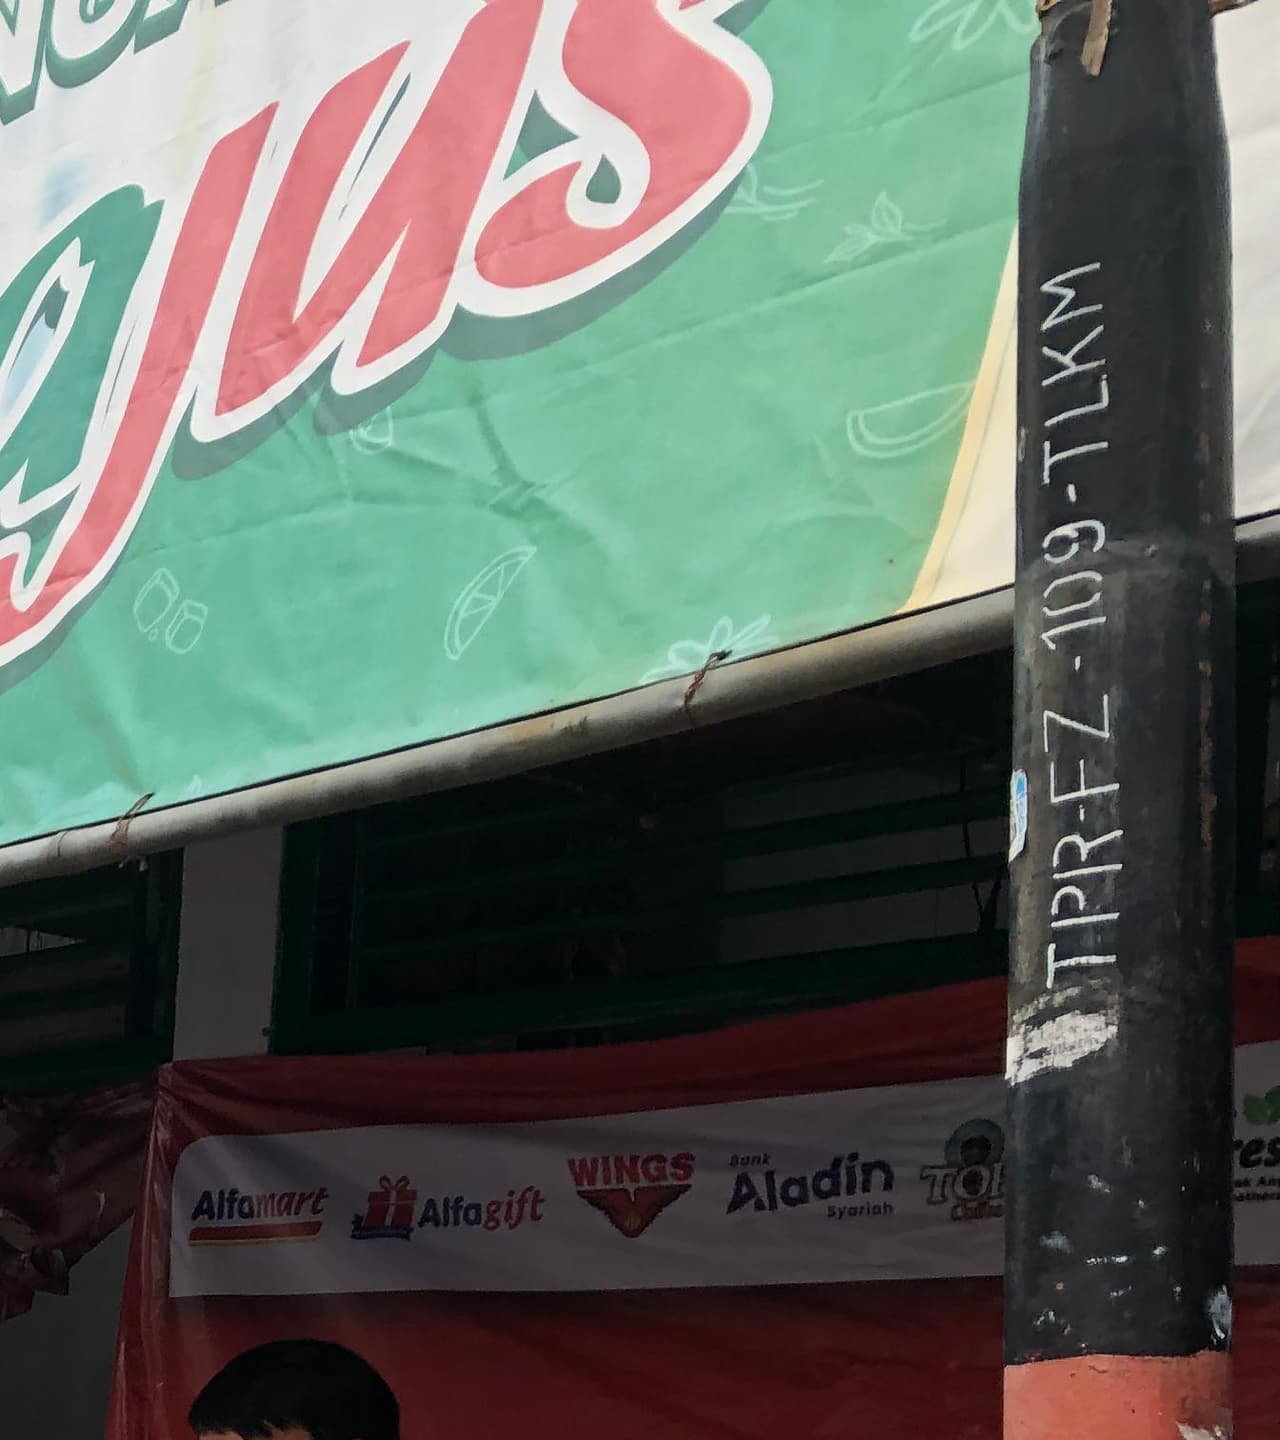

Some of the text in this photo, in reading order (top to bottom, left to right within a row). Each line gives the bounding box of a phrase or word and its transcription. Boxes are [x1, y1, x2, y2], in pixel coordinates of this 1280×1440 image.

[567, 1152, 696, 1187] WINGS
[729, 1152, 771, 1168] Bank
[726, 1152, 895, 1215] Aladin
[191, 1186, 329, 1223] Alfamart
[419, 1184, 545, 1233] Alfagift
[827, 1201, 895, 1221] Syariah
